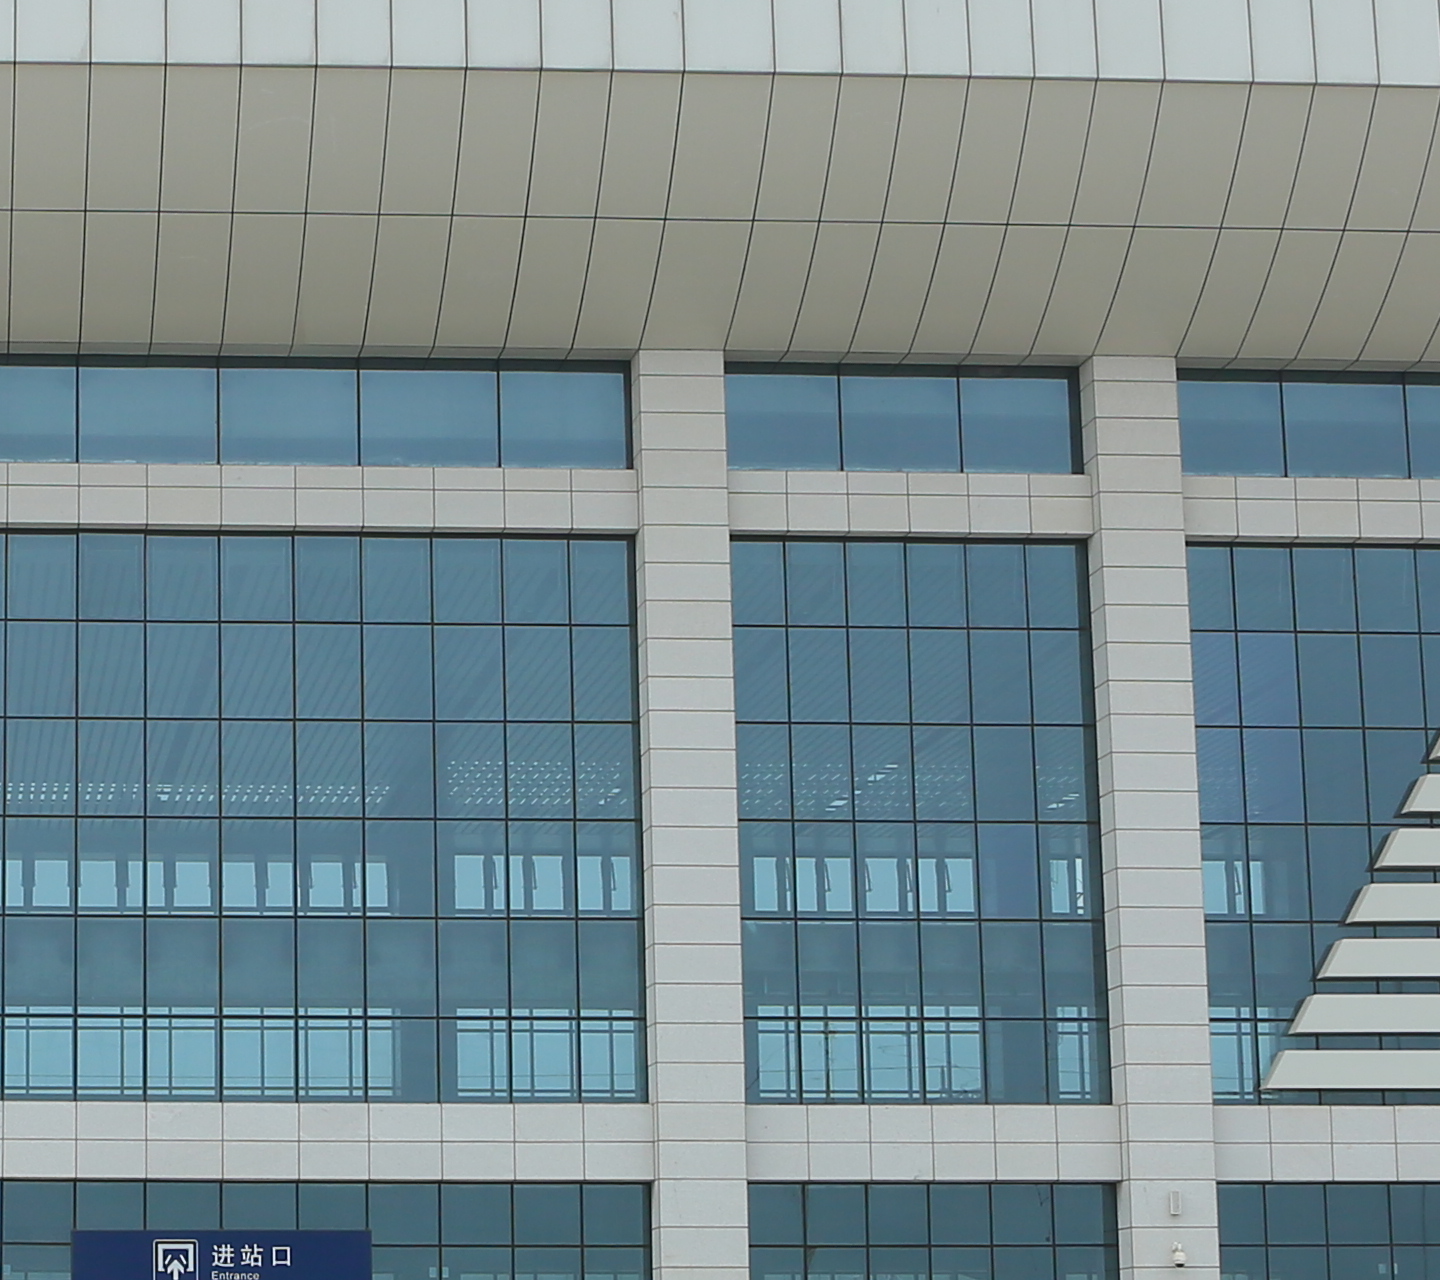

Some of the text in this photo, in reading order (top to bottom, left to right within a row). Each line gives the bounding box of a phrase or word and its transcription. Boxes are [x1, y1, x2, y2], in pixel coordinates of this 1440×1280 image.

[211, 1244, 292, 1267] 进站口
[211, 1271, 260, 1280] Entrance
